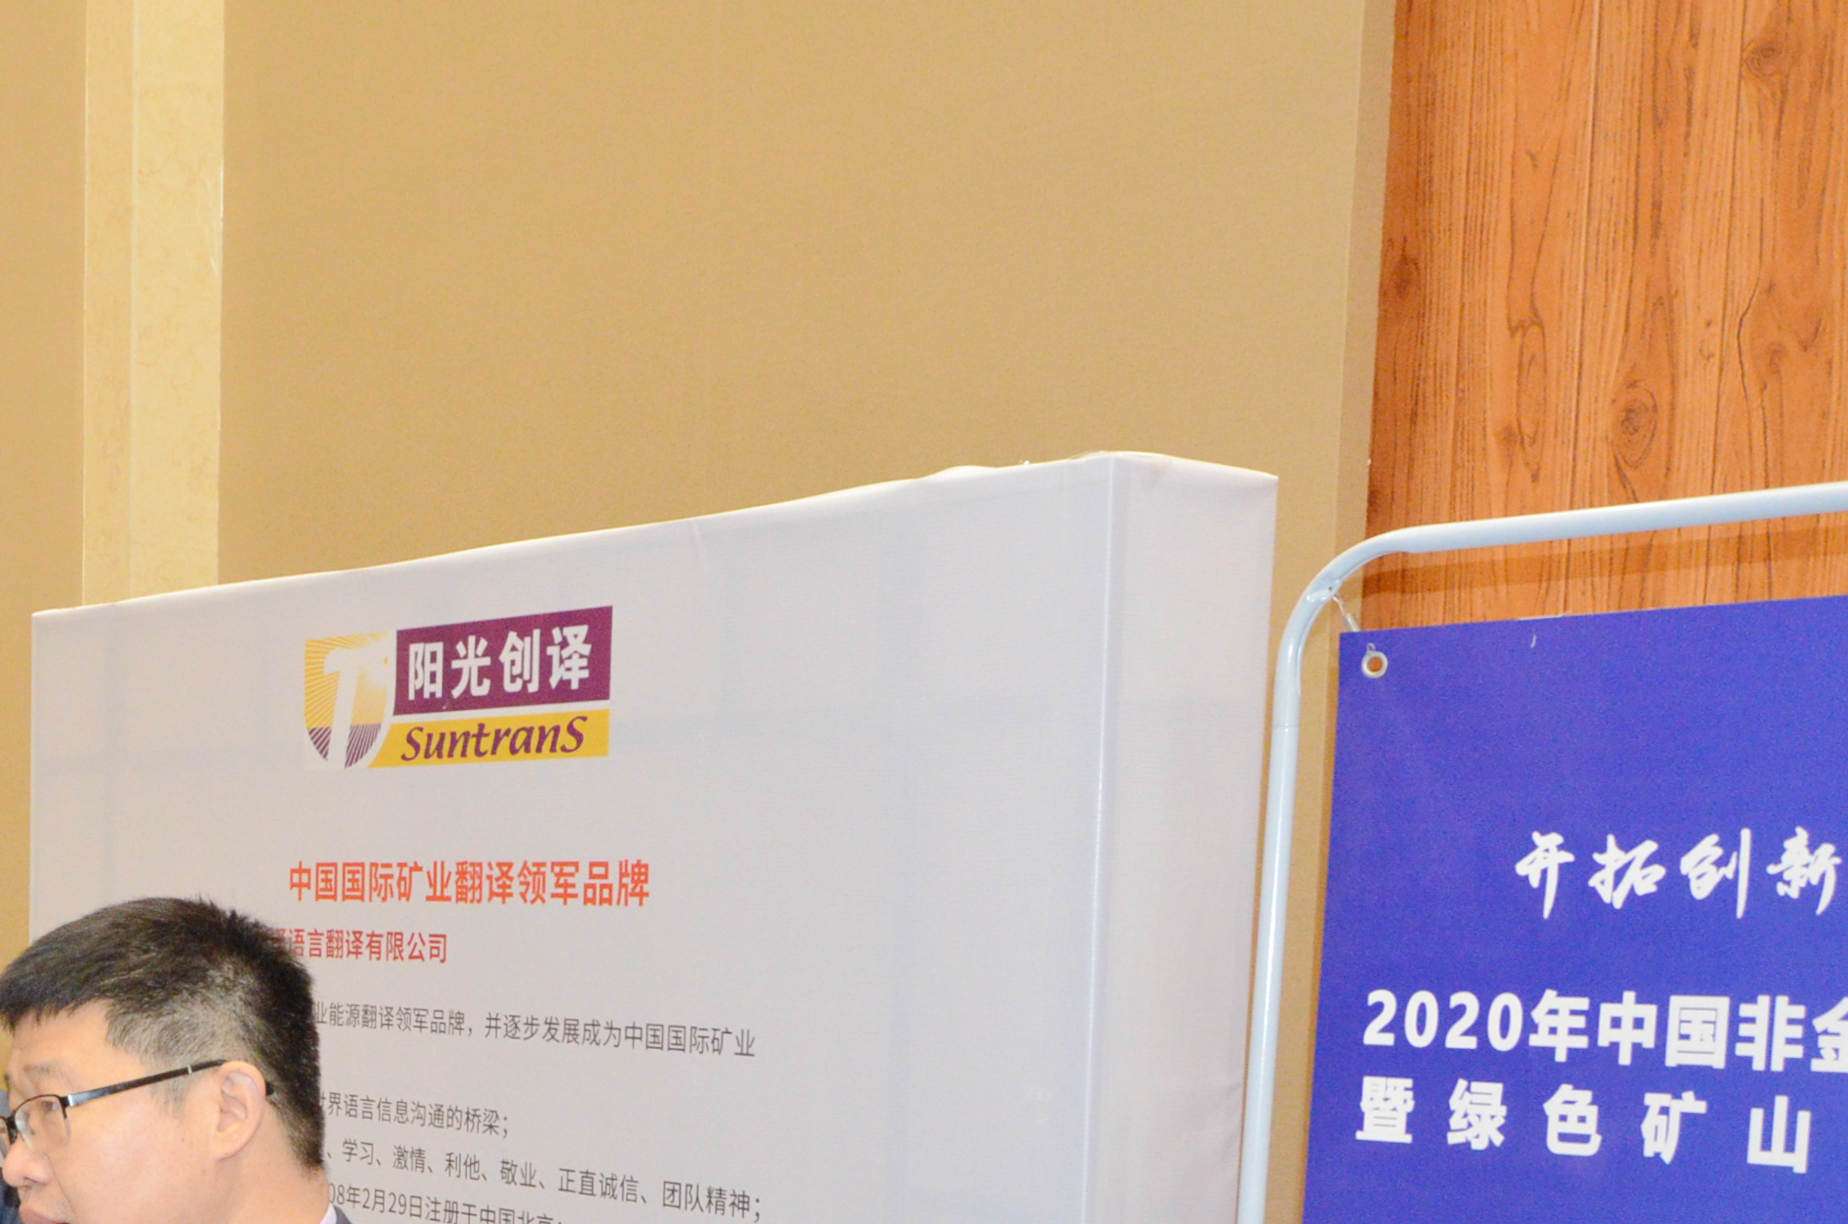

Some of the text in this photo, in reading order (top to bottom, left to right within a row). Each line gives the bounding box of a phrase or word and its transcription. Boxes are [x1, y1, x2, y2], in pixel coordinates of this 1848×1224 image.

[408, 624, 593, 700] 阳光创译
[401, 715, 588, 762] SuntranS
[289, 859, 650, 908] 中国国际矿业翻译领军品牌
[1515, 826, 1842, 919] 开拓创新
[273, 928, 448, 964] 语言翻译有限公司
[1356, 1076, 1812, 1174] 暨绿色矿山
